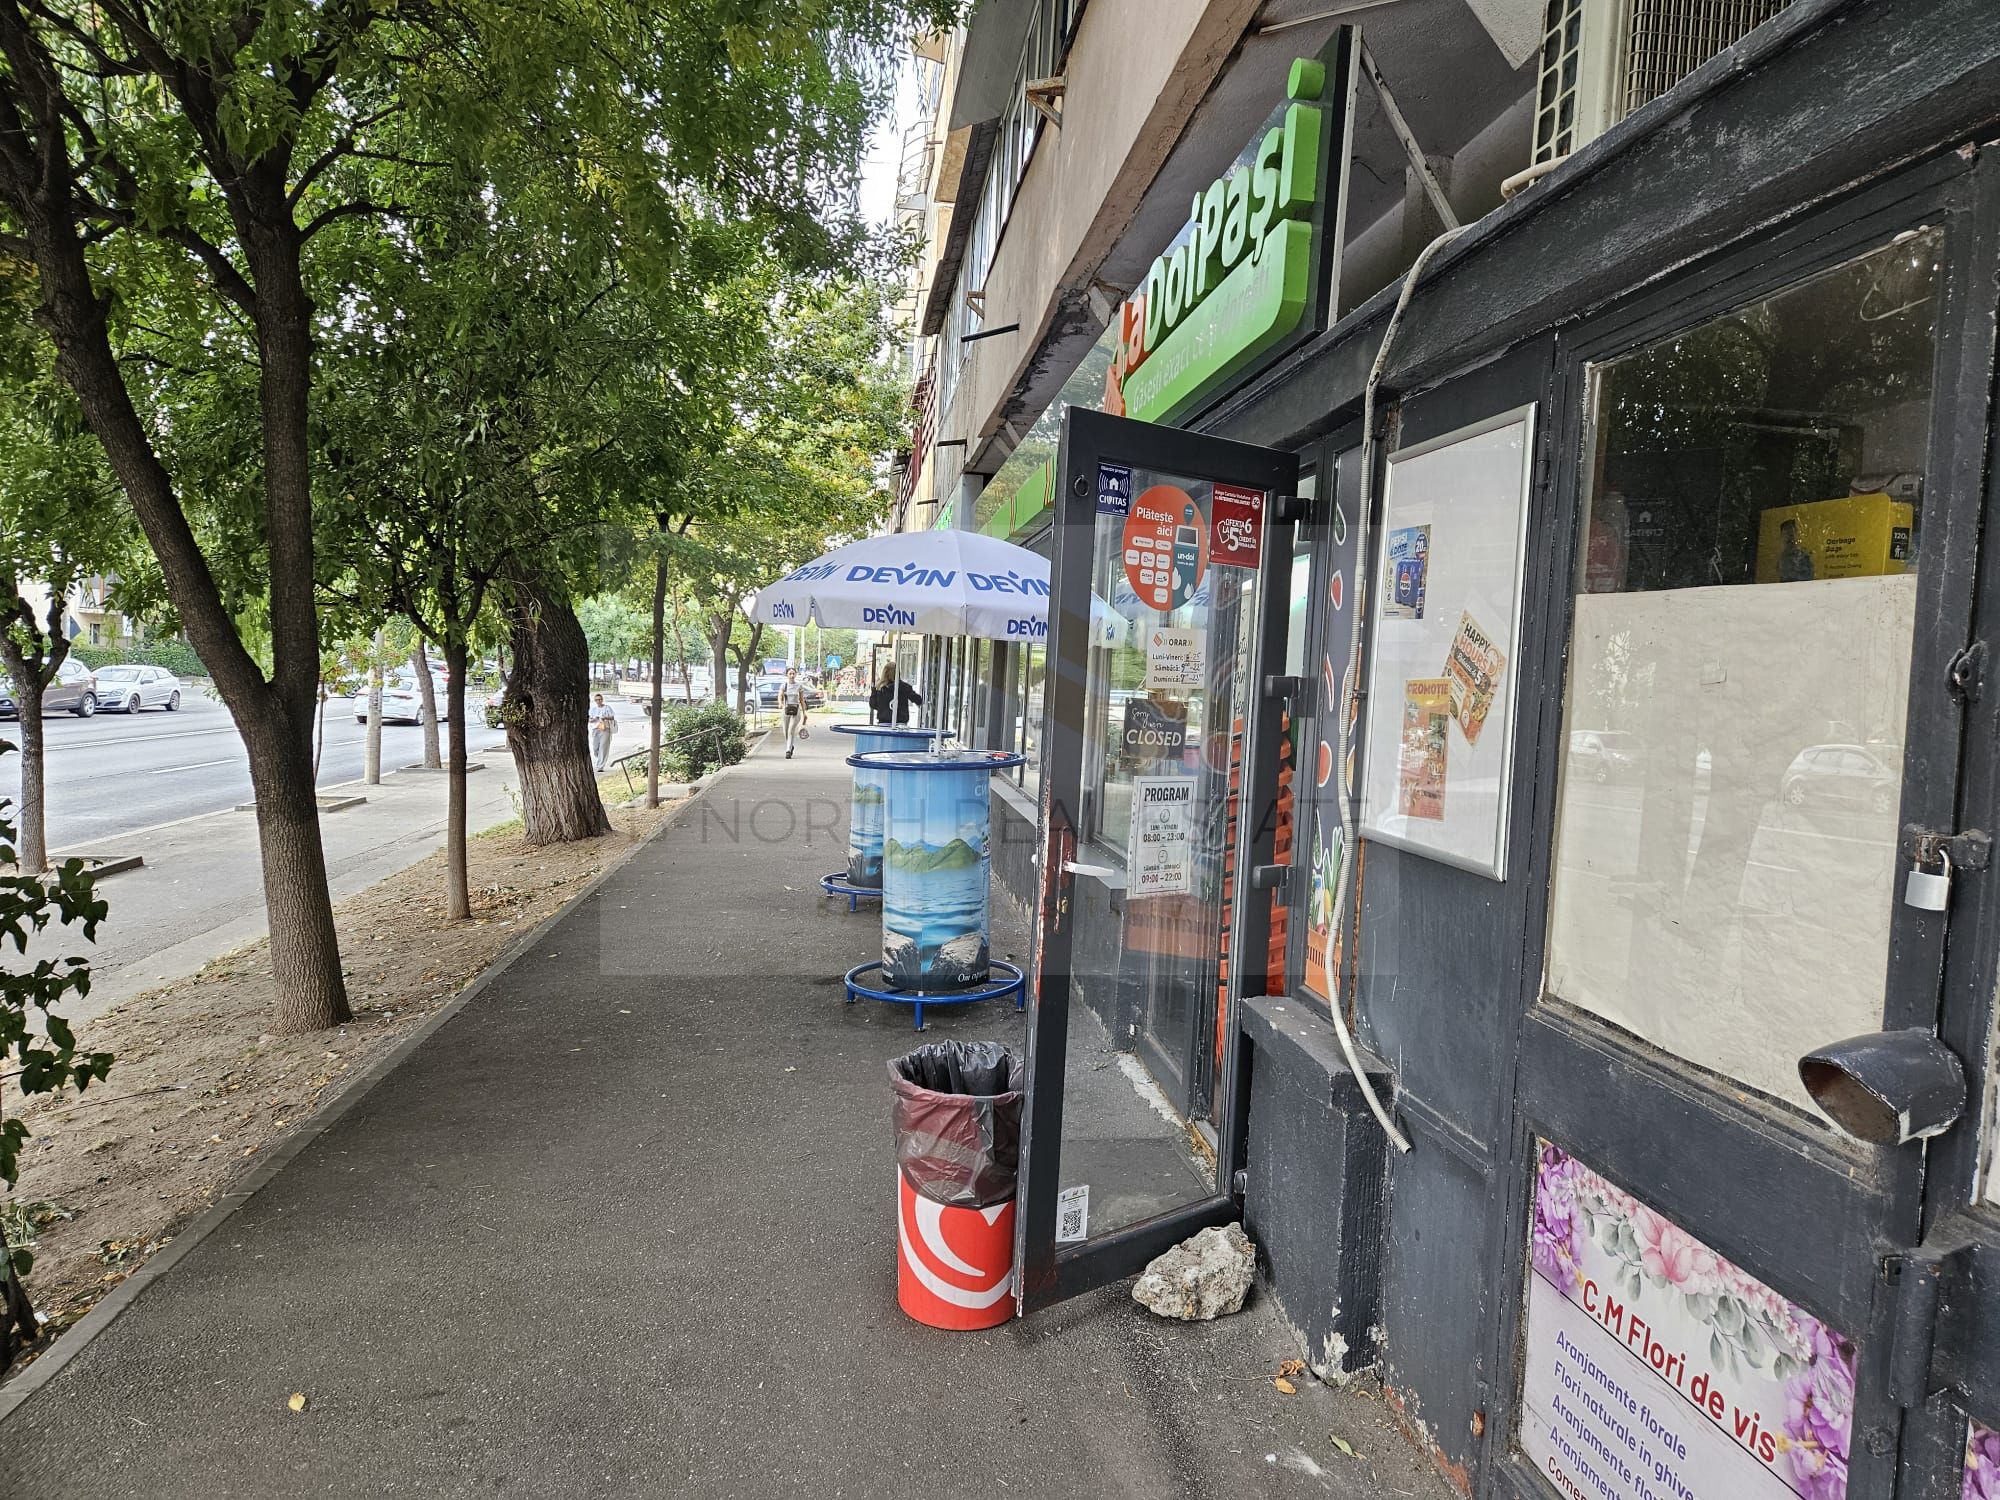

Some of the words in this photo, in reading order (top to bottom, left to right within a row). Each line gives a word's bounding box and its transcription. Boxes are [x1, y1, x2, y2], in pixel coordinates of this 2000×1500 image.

[1099, 494, 1127, 506] CIVITAS
[1136, 506, 1174, 525] Plătește
[1226, 519, 1245, 528] OFERTA
[1157, 526, 1173, 537] aici
[784, 560, 844, 581] DEVIN
[846, 562, 957, 588] DEVIN
[773, 599, 794, 619] DEVIN
[863, 604, 915, 626] DEVIN
[1168, 638, 1187, 647] ORAR
[1464, 623, 1490, 653] HAPPY
[1459, 637, 1488, 672] HOURS
[1407, 683, 1449, 699] PROMOȚIE
[1126, 729, 1182, 747] CLOSED
[1144, 787, 1189, 802] PROGRAM
[1167, 832, 1185, 841] 23:00
[1165, 872, 1181, 881] 22:00
[1583, 1279, 1624, 1336] C.M
[1627, 1313, 1686, 1388] Flori
[1690, 1372, 1725, 1420] de
[1733, 1406, 1776, 1463] vis
[1556, 1330, 1637, 1415] Aranjamente
[1640, 1405, 1686, 1460] florale
[1554, 1360, 1581, 1398] Flori
[1583, 1391, 1637, 1452] naturale
[1639, 1441, 1652, 1467] in
[1552, 1394, 1632, 1484] Aranjamente
[1634, 1475, 1664, 1500] flo
